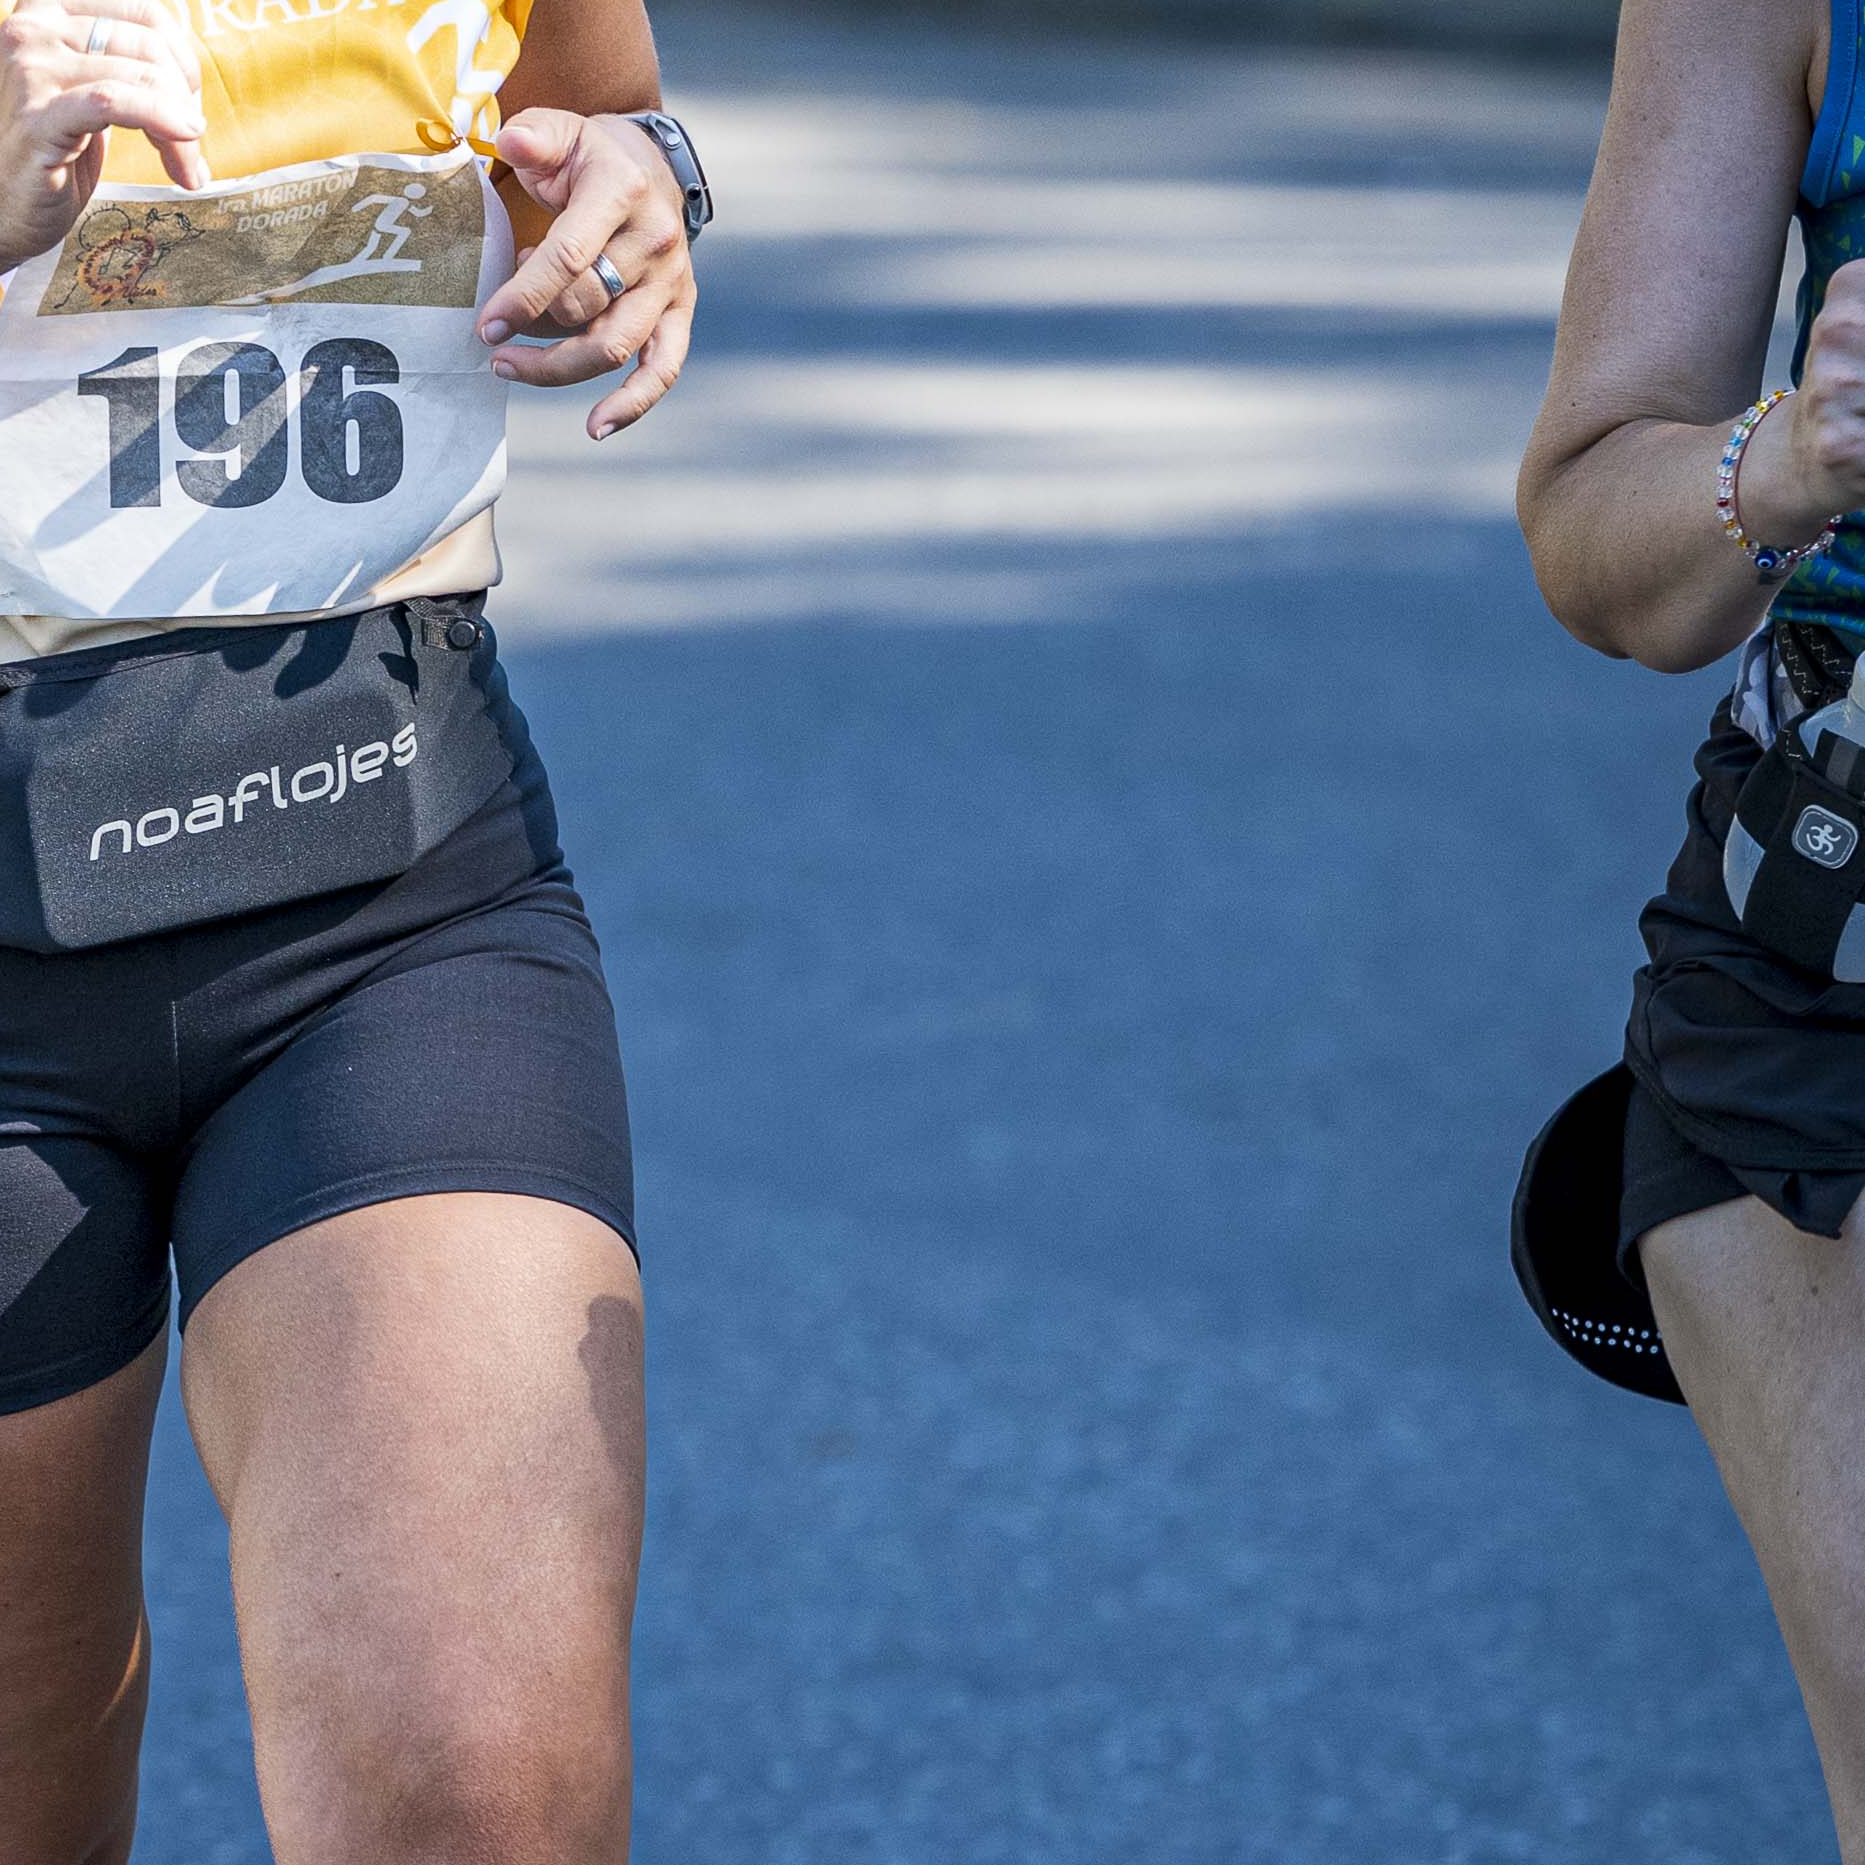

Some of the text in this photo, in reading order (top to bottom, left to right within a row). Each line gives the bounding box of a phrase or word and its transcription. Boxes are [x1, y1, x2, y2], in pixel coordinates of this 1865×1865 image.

[236, 199, 329, 233] DORADA
[77, 337, 404, 509] 196
[89, 722, 419, 862] noaflojes
